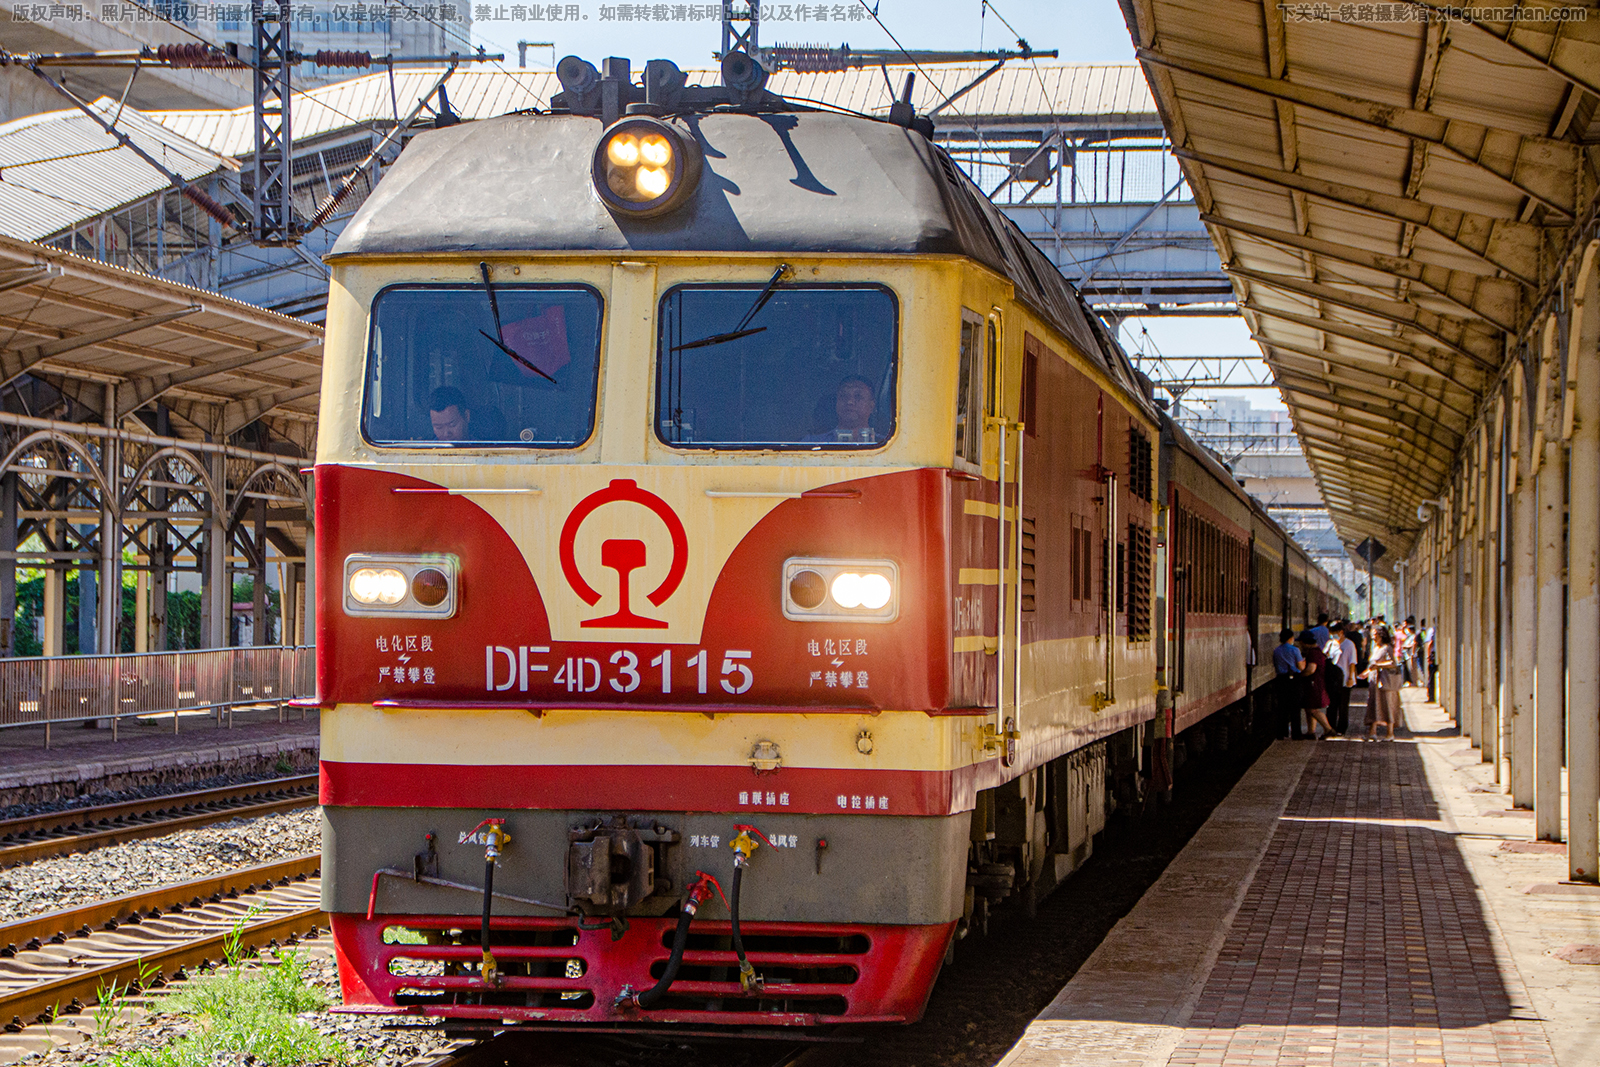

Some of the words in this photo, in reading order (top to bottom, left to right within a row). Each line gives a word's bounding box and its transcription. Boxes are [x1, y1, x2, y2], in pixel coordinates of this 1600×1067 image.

[375, 634, 433, 652] 电化区段
[807, 638, 868, 656] 电化区段
[378, 666, 436, 684] 严禁攀登
[809, 670, 869, 688] 严禁攀登
[738, 791, 790, 806] 重联插座
[837, 795, 889, 810] 电控插座
[690, 834, 720, 848] 列车管
